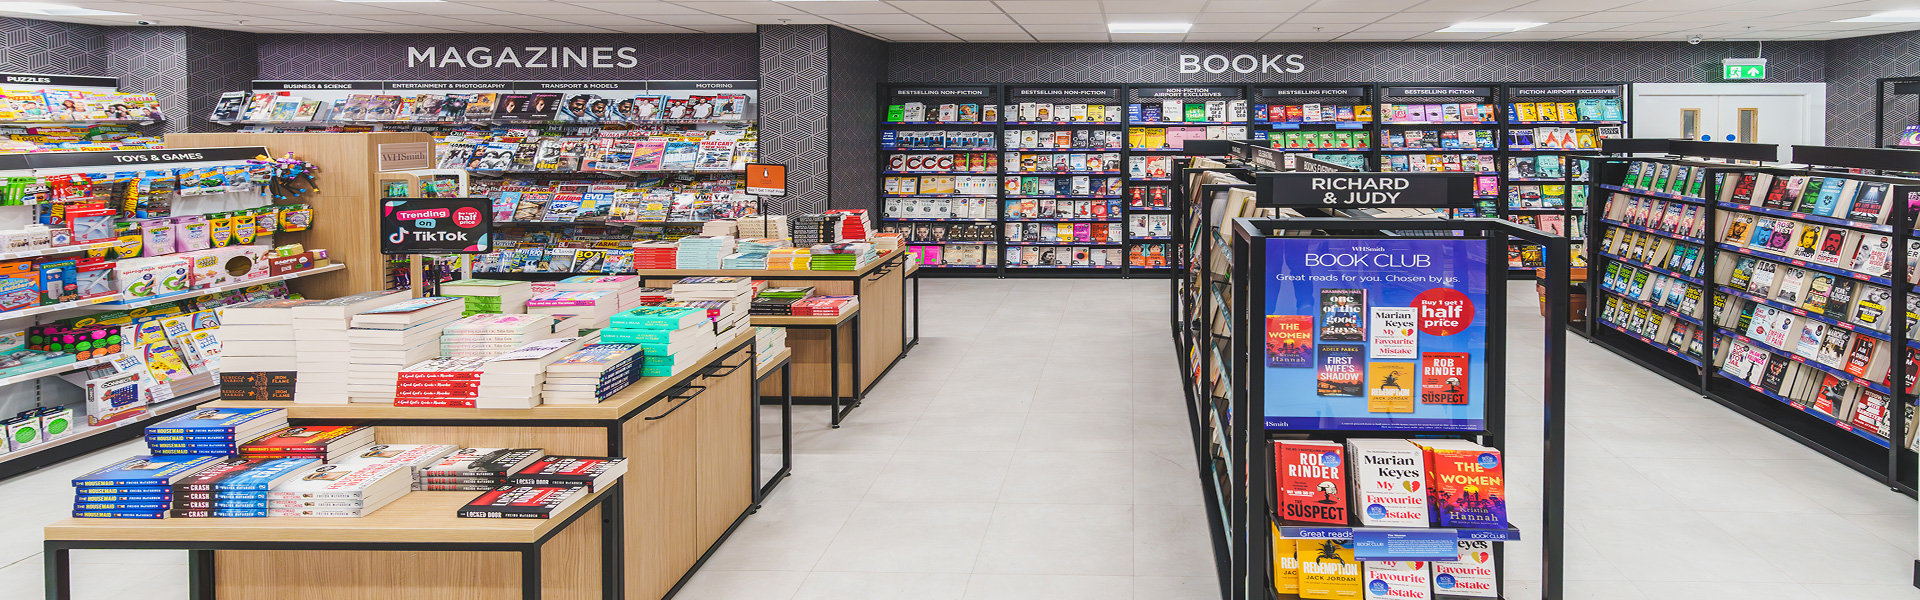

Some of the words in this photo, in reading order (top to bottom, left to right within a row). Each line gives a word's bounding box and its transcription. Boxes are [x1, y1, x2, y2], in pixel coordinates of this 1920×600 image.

[407, 46, 638, 68] MAGAZINES
[1179, 54, 1305, 74] BOOKS
[6, 76, 51, 84] PUZZLES
[113, 155, 149, 163] TOYS
[162, 152, 204, 161] GAMES
[382, 151, 426, 162] WHSmith
[1312, 177, 1409, 191] RICHARD
[1323, 193, 1337, 205] &
[1344, 192, 1401, 205] JUDY
[400, 210, 447, 219] Trending
[412, 231, 468, 242] TikTok
[1305, 253, 1369, 267] BOOK
[1373, 253, 1431, 268] CLUB
[1276, 273, 1306, 282] Great
[1308, 273, 1339, 282] reads
[1341, 274, 1357, 282] for
[1360, 275, 1382, 283] you.
[1385, 274, 1426, 283] Chosen
[1429, 274, 1443, 284] by
[1329, 295, 1355, 303] one
[1322, 303, 1336, 313] of
[1340, 304, 1361, 313] the
[1421, 305, 1463, 318] half
[1326, 314, 1357, 325] good
[1385, 320, 1415, 329] Keyes
[1424, 318, 1459, 328] price
[1279, 323, 1300, 331] THE
[1326, 326, 1358, 336] guys
[1268, 331, 1311, 339] WOMEN
[1374, 337, 1415, 345] Favourite
[1379, 347, 1413, 355] Mistake
[1327, 356, 1353, 365] FIRST
[1433, 358, 1455, 367] ROB
[1324, 364, 1356, 373] WIFE'S
[1424, 366, 1463, 376] RINDER
[1320, 372, 1360, 381] SHADOW
[1371, 388, 1411, 397] REDEMPTION
[1422, 393, 1465, 403] SUSPECT
[1364, 454, 1415, 467] Marian
[1288, 463, 1340, 480] RINDER
[1453, 461, 1484, 473] THE
[1378, 467, 1420, 480] Keyes
[516, 478, 535, 486] LOCKED
[1376, 480, 1395, 491] My
[1440, 473, 1501, 487] WOMEN
[190, 501, 210, 509] CRASH
[1366, 494, 1423, 506] Favourite
[466, 511, 487, 519] LOCKED
[487, 511, 502, 519] DOOR
[1287, 503, 1345, 521] SUSPECT
[1386, 508, 1422, 520] istake
[1459, 506, 1489, 514] Kristin
[1449, 512, 1499, 523] Hannah
[1299, 529, 1326, 538] Great
[1327, 529, 1354, 538] reads
[1457, 540, 1489, 550] eyes
[1303, 561, 1359, 577] REDEMPTION
[1436, 564, 1491, 577] Favourite
[1370, 570, 1426, 585] Favourite
[1453, 580, 1491, 591] istake
[1386, 586, 1425, 599] istake
